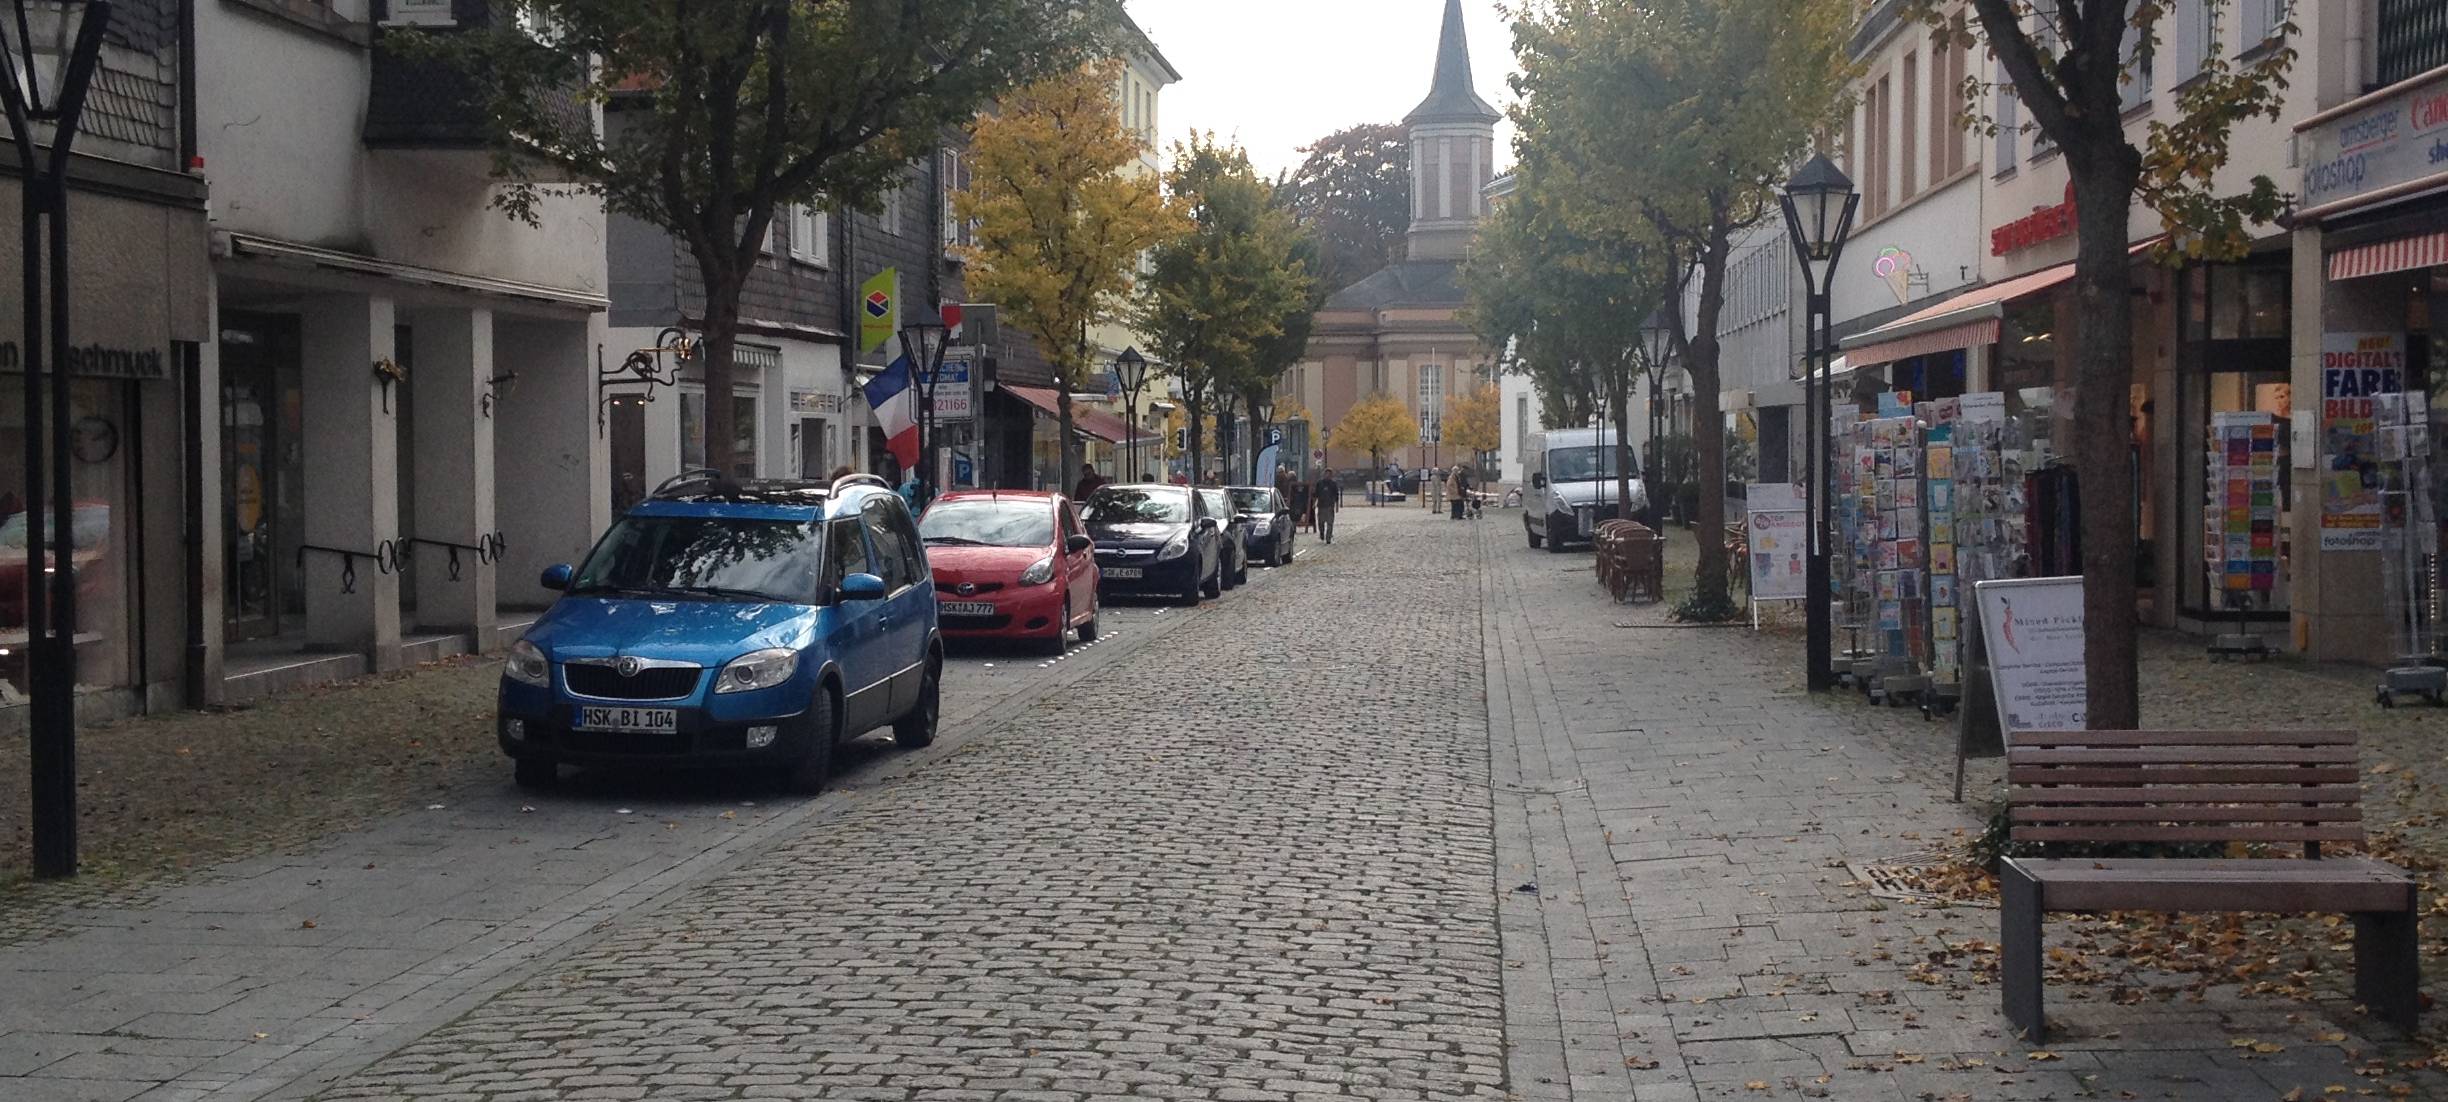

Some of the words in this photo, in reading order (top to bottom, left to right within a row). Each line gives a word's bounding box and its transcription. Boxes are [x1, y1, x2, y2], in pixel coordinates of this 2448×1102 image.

[959, 463, 970, 478] P
[583, 708, 611, 726] HSK
[621, 710, 640, 727] BI
[645, 710, 674, 728] 104
